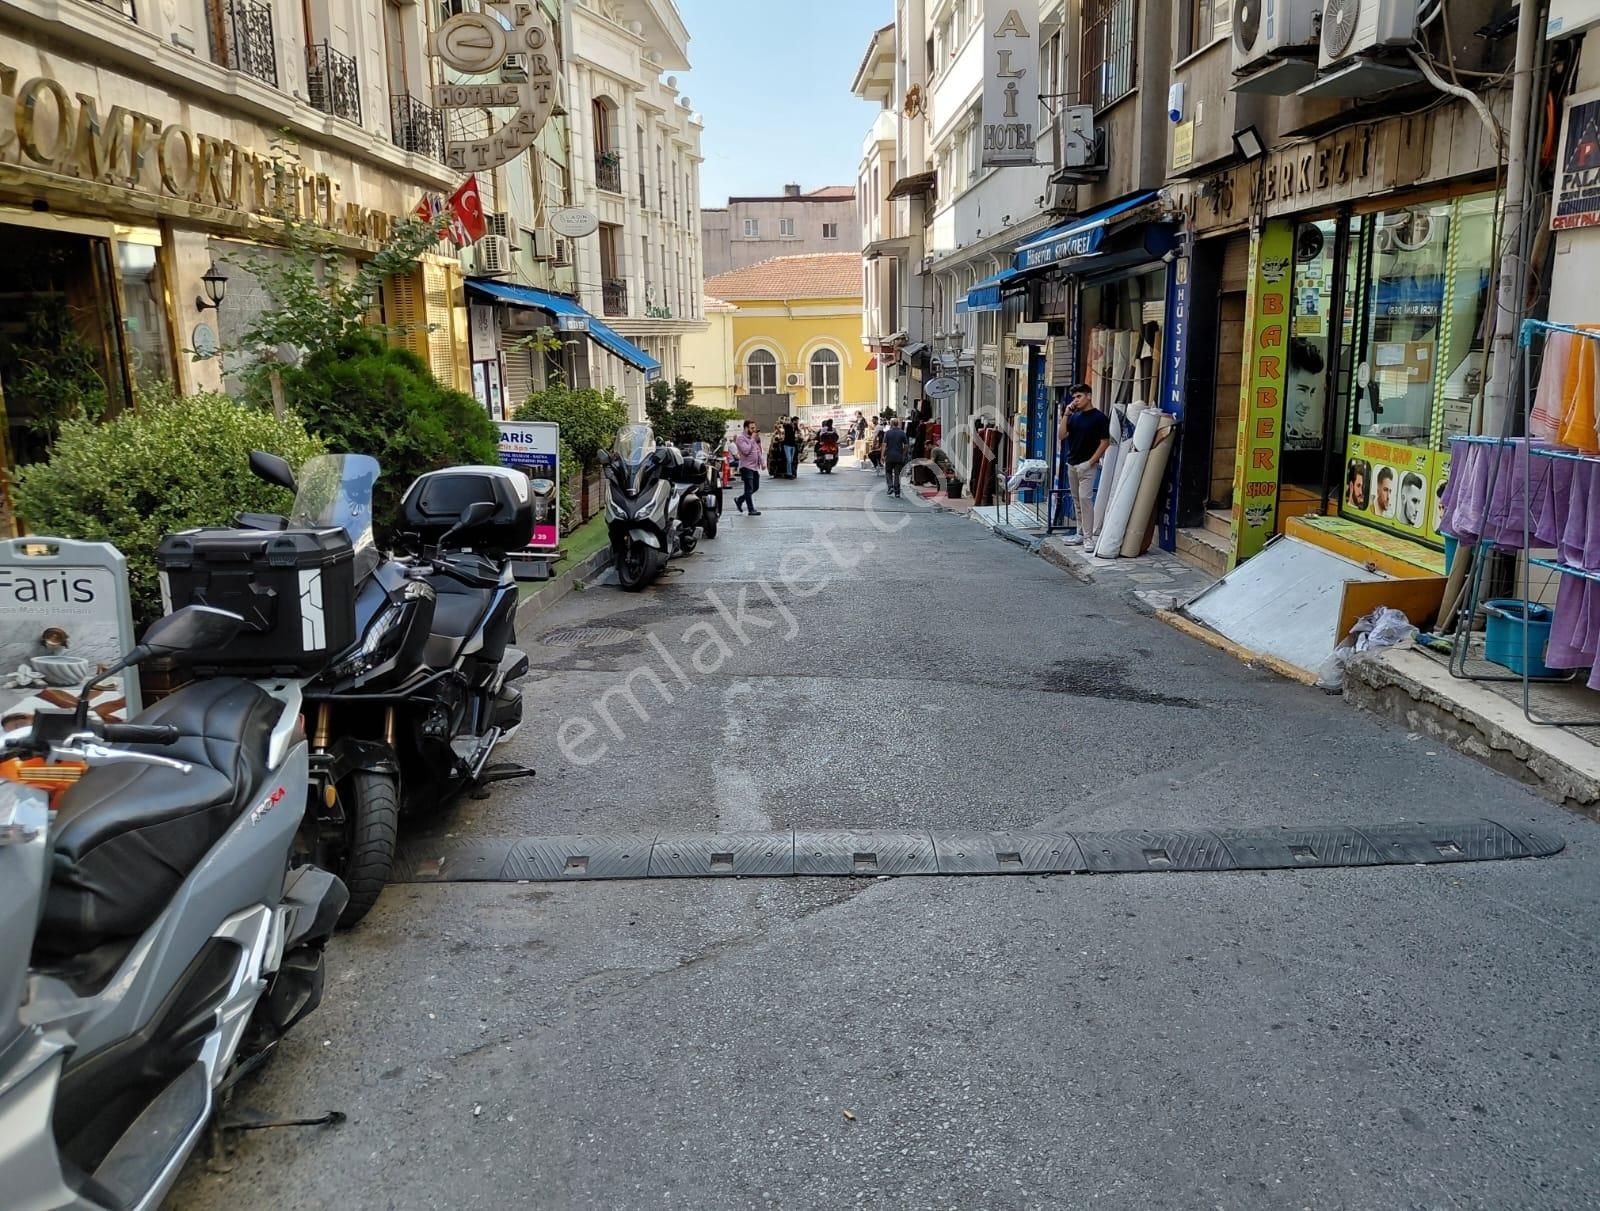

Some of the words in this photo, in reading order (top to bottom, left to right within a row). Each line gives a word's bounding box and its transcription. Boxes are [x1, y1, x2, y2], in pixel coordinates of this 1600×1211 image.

[994, 9, 1030, 118] ALİ
[438, 86, 520, 106] HOTELS
[983, 124, 1035, 150] HOTEL
[1253, 293, 1284, 471] BARBER
[500, 431, 534, 444] ARİS
[1246, 481, 1276, 497] SHOP
